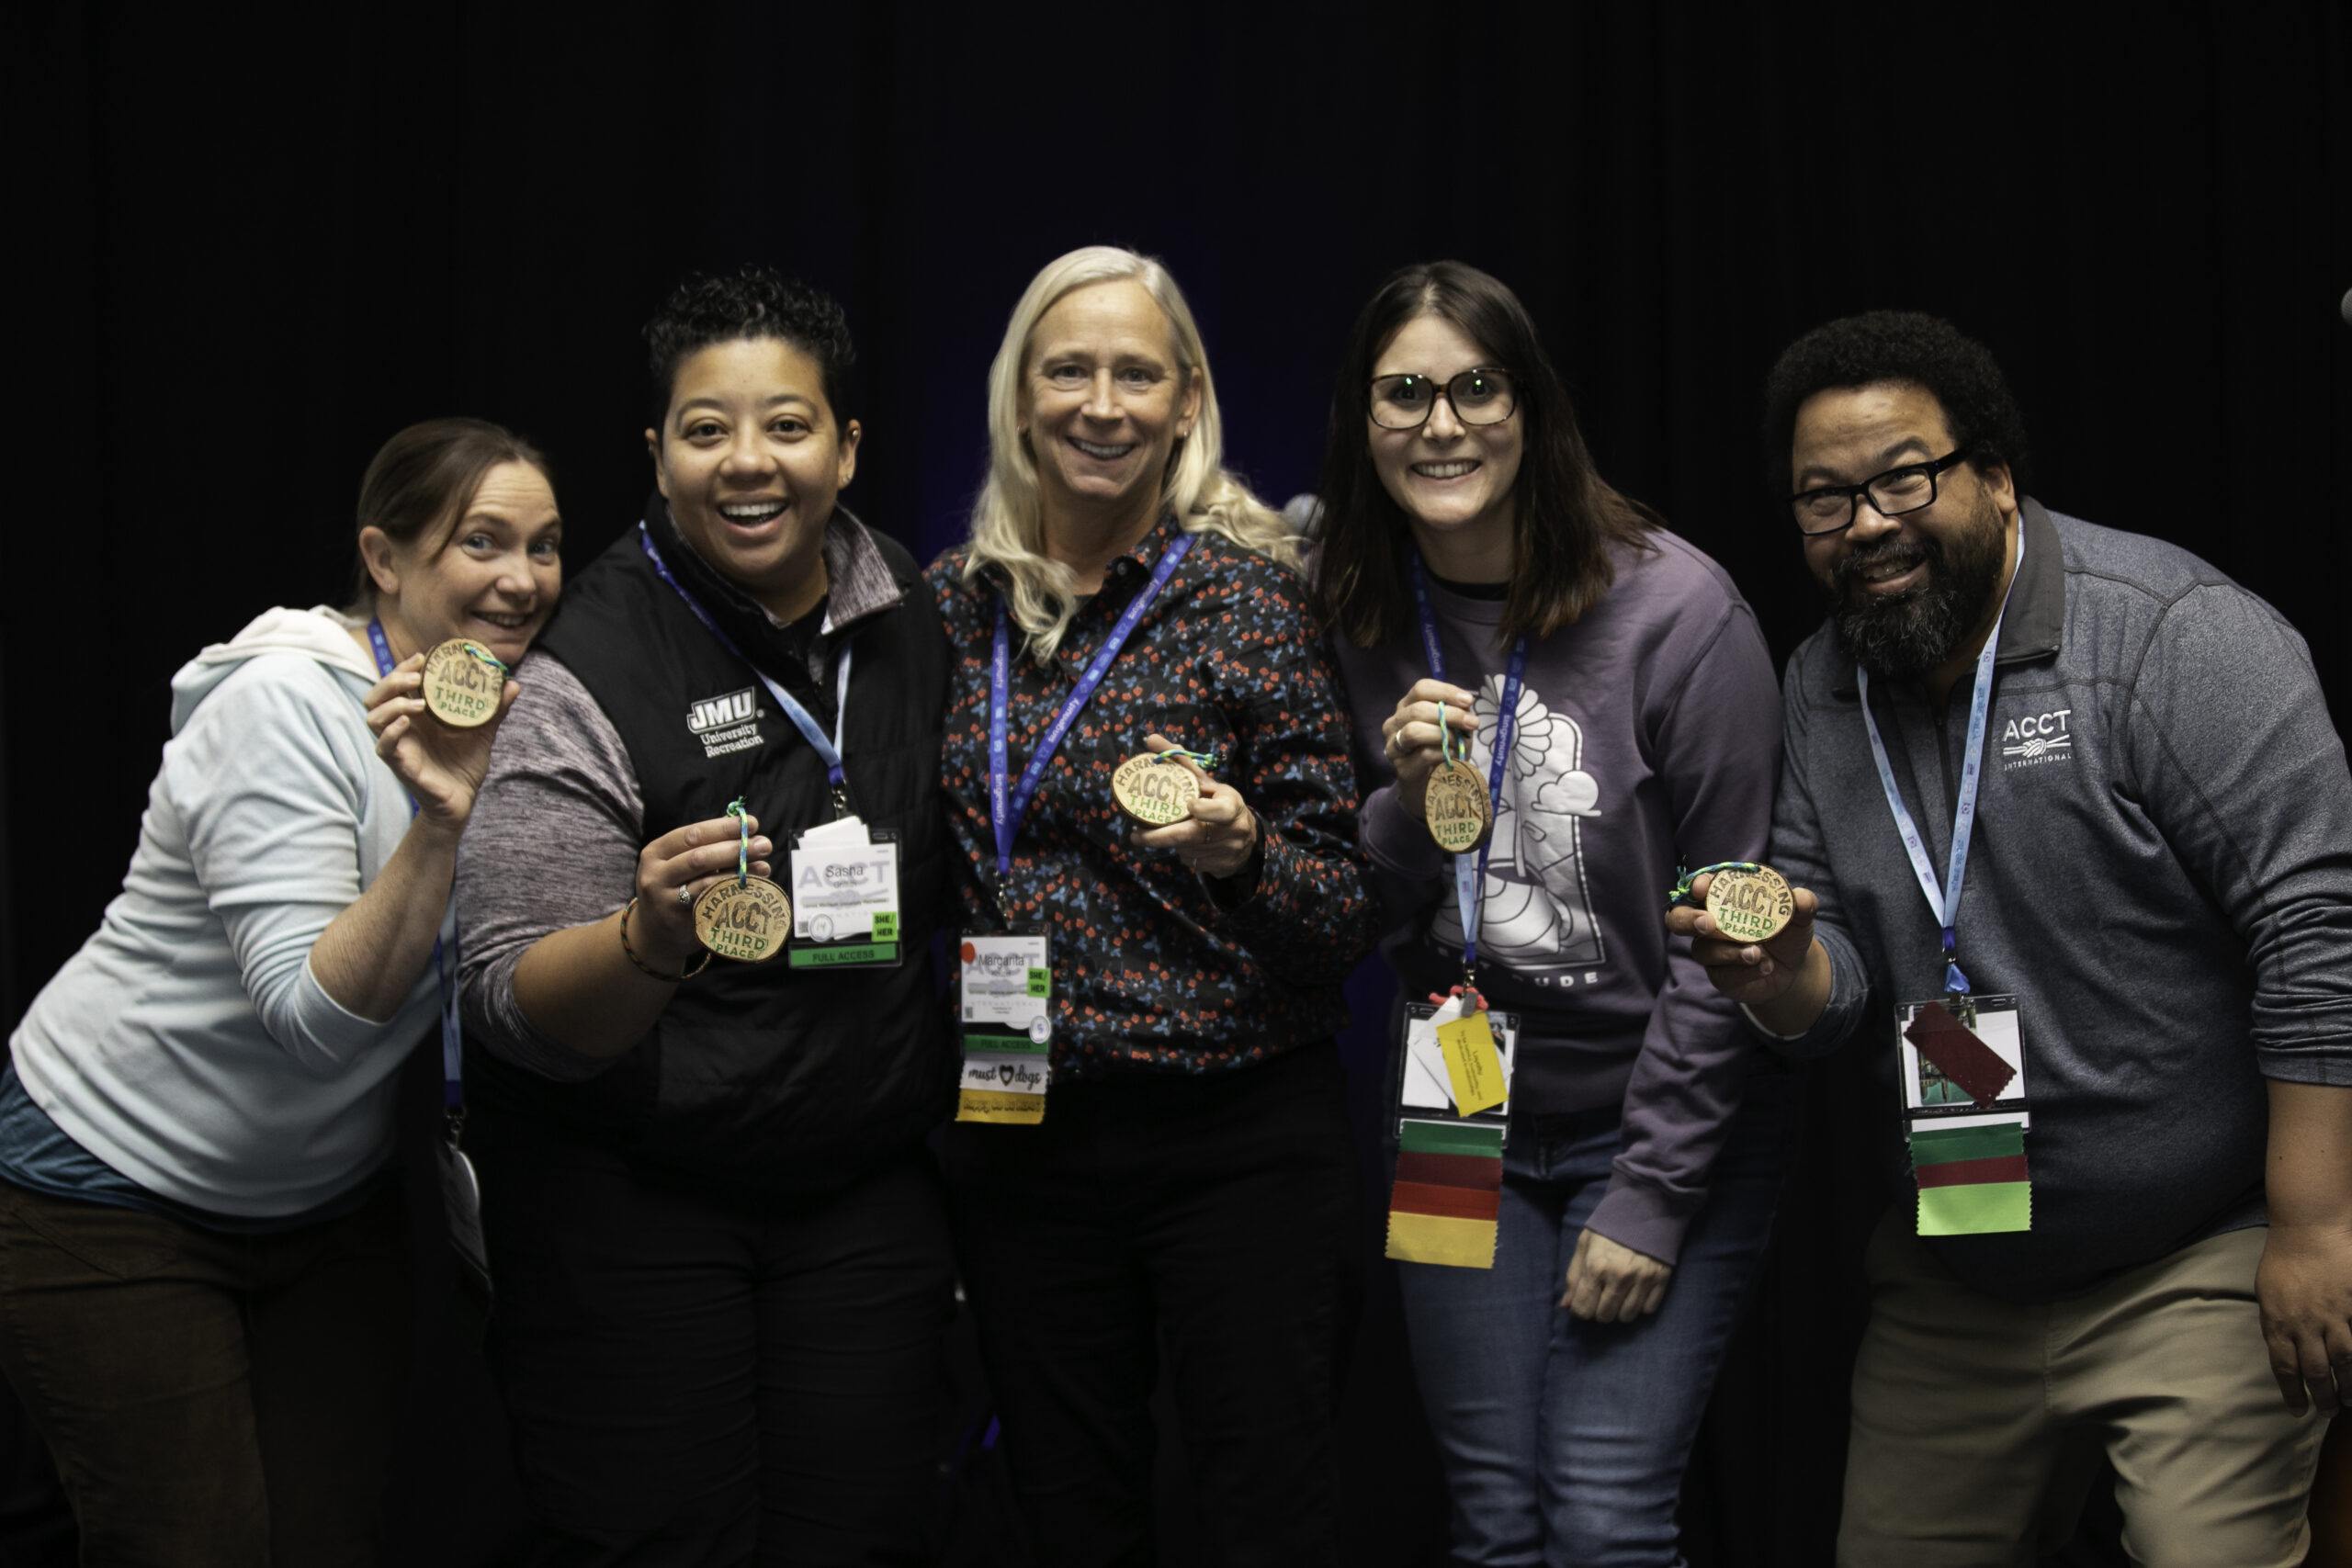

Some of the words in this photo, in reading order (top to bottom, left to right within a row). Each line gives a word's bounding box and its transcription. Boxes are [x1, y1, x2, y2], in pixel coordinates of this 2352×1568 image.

[438, 660, 489, 694] ACCT
[435, 685, 485, 711] THIRD
[440, 701, 477, 718] PLACE
[689, 691, 752, 730] JMU
[700, 723, 756, 745] University
[2003, 709, 2071, 742] ACCT
[705, 735, 763, 758] Recreation
[2004, 753, 2071, 771] INTERNATIONAL
[1126, 773, 1182, 806] ACCT
[1129, 794, 1182, 817] THIRD
[1135, 808, 1171, 824] PLACE
[1435, 791, 1473, 821] ACCT
[1435, 822, 1476, 839] THIRD
[1442, 835, 1471, 846] PLACE
[825, 863, 864, 878] Sasha
[1721, 883, 1778, 917] ACCT
[714, 901, 771, 935] ACCT
[1719, 908, 1773, 931] THIRD
[710, 927, 767, 951] THIRD
[876, 928, 893, 936] HER
[1724, 922, 1764, 938] PLACE
[715, 943, 754, 959] PLACE
[812, 952, 835, 963] FULL
[838, 949, 875, 961] ACCESS
[978, 954, 1024, 969] Margarita
[1030, 984, 1046, 993] HER
[968, 1066, 997, 1081] must
[1015, 1065, 1043, 1091] dogs
